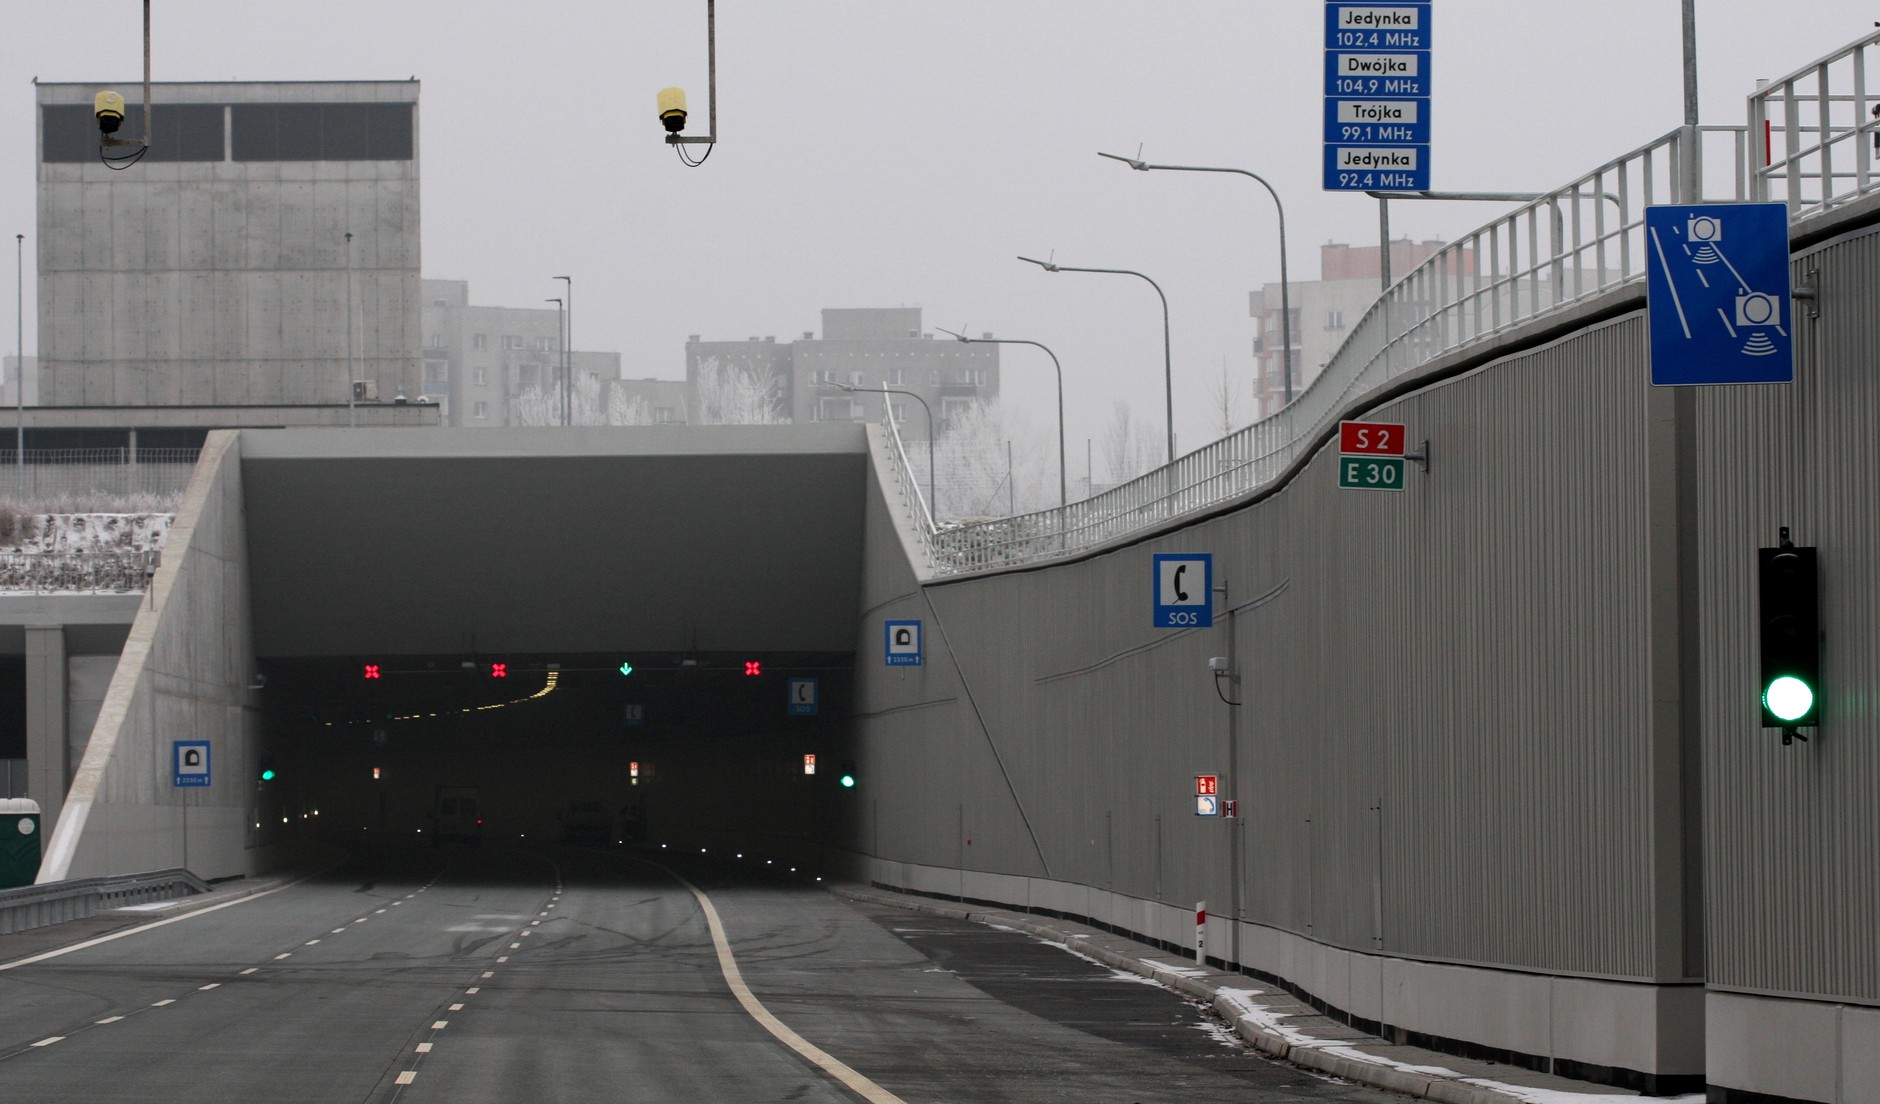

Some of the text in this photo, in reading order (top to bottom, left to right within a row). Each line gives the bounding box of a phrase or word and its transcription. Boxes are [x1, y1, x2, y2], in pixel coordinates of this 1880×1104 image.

[1345, 11, 1411, 28] Jedynka
[1337, 32, 1419, 47] 102,4 MHz
[1348, 58, 1407, 75] Dwójka
[1336, 79, 1419, 94] 104,9 MHz
[1353, 104, 1402, 122] Trójka
[1341, 126, 1413, 141] 99,1 MHz
[1344, 152, 1410, 169] Jedynka
[1339, 173, 1414, 188] 92,4 MHz
[1356, 429, 1390, 449] S 2
[1347, 463, 1396, 484] E 30
[1168, 612, 1198, 625] SOS
[1198, 940, 1204, 948] 2
